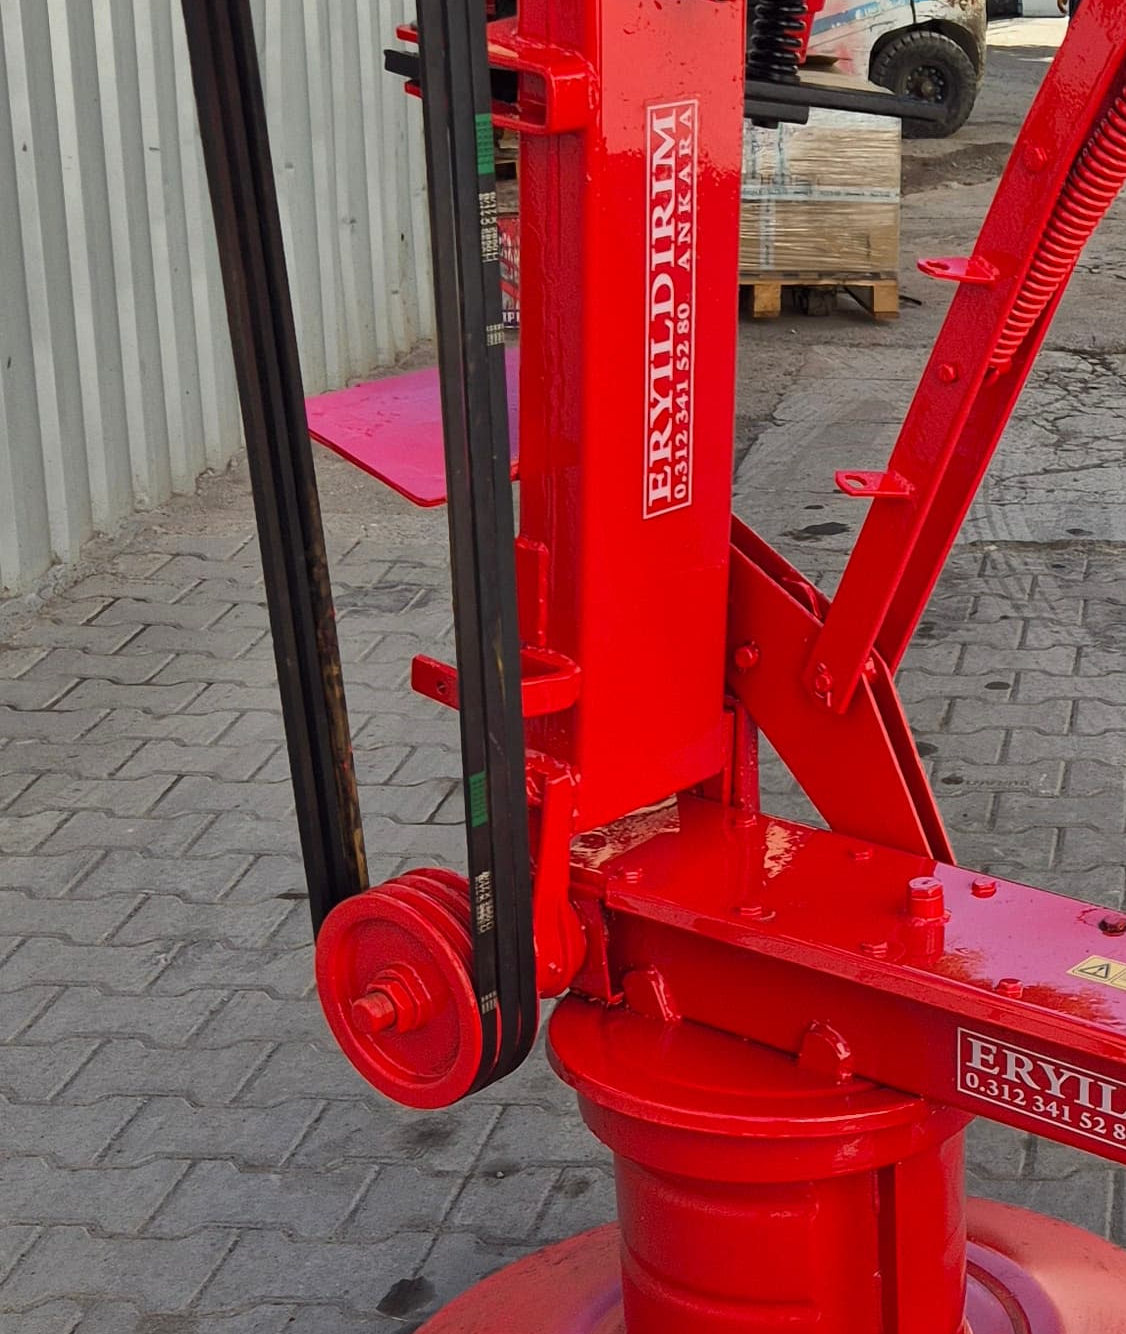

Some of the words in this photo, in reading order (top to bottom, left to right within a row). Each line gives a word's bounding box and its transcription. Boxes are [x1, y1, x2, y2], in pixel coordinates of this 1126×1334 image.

[677, 107, 692, 271] ANKARA
[648, 107, 677, 507] ERYILDIRIM
[677, 303, 690, 336] 80
[676, 340, 690, 371] 52
[675, 379, 689, 424] 341
[674, 429, 689, 500] 0.312
[964, 1071, 1027, 1107] 0.312
[1033, 1096, 1072, 1123] 341
[1079, 1112, 1108, 1136] 52
